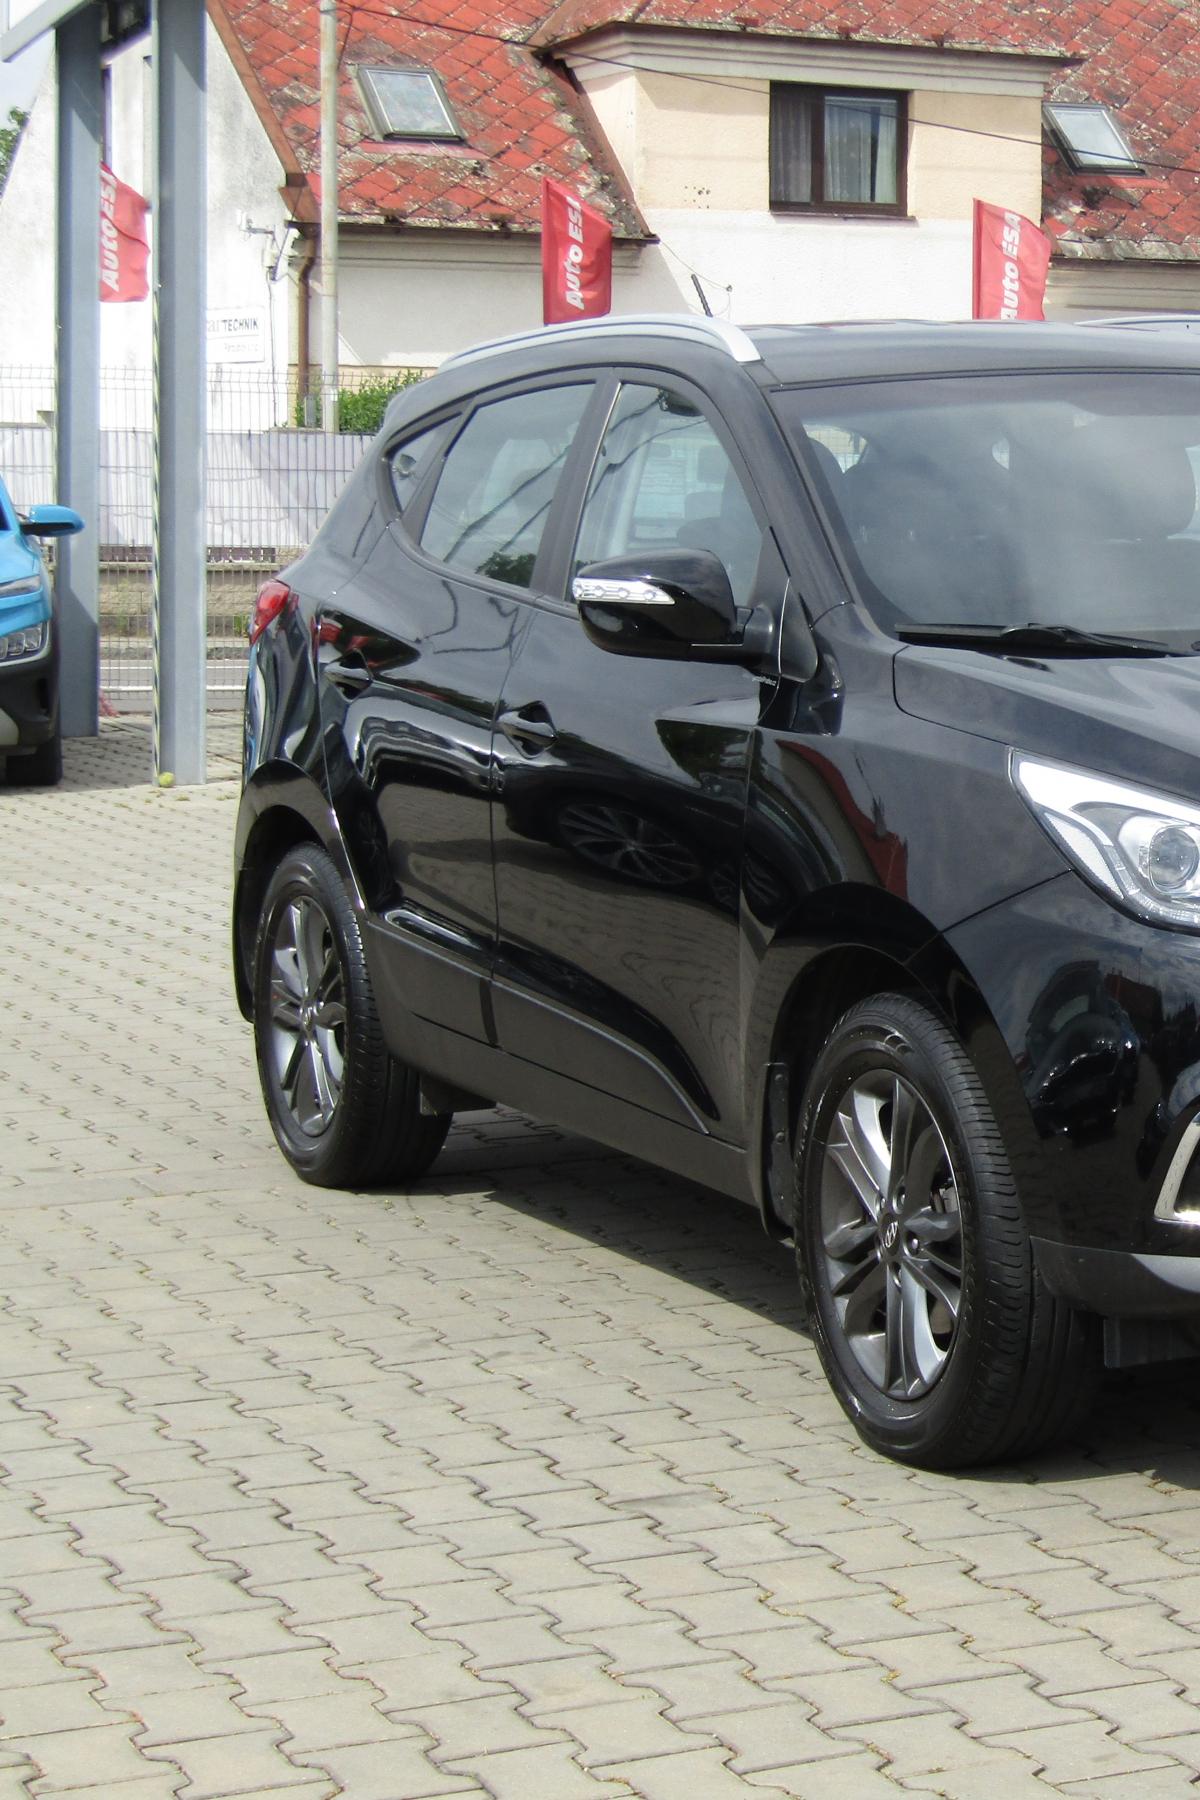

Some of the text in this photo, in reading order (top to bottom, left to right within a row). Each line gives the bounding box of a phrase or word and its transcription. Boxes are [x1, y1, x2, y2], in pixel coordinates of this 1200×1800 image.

[101, 219, 120, 292] Auto
[1002, 210, 1021, 260] ESA
[565, 244, 585, 310] Auto
